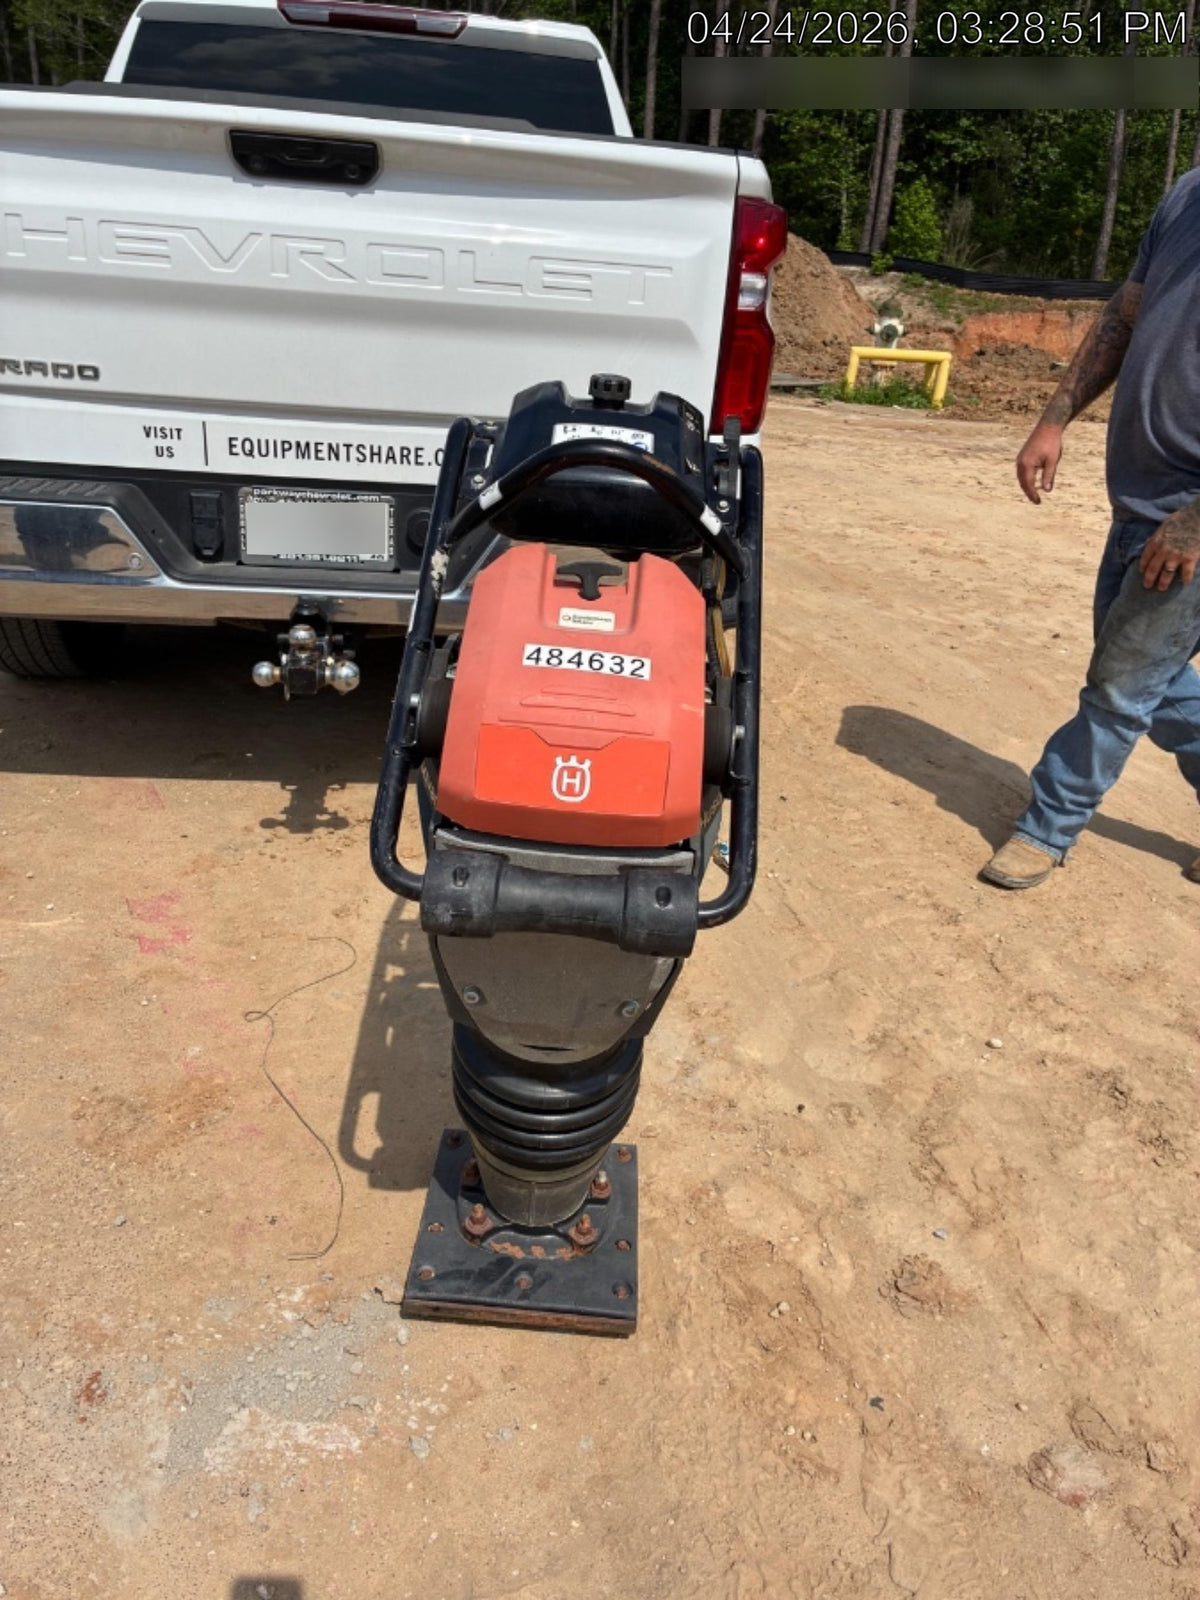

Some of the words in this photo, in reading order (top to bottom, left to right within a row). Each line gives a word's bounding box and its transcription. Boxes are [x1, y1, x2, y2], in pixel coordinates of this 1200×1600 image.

[143, 425, 183, 441] VISIT
[155, 445, 175, 459] US
[525, 646, 646, 679] 484632
